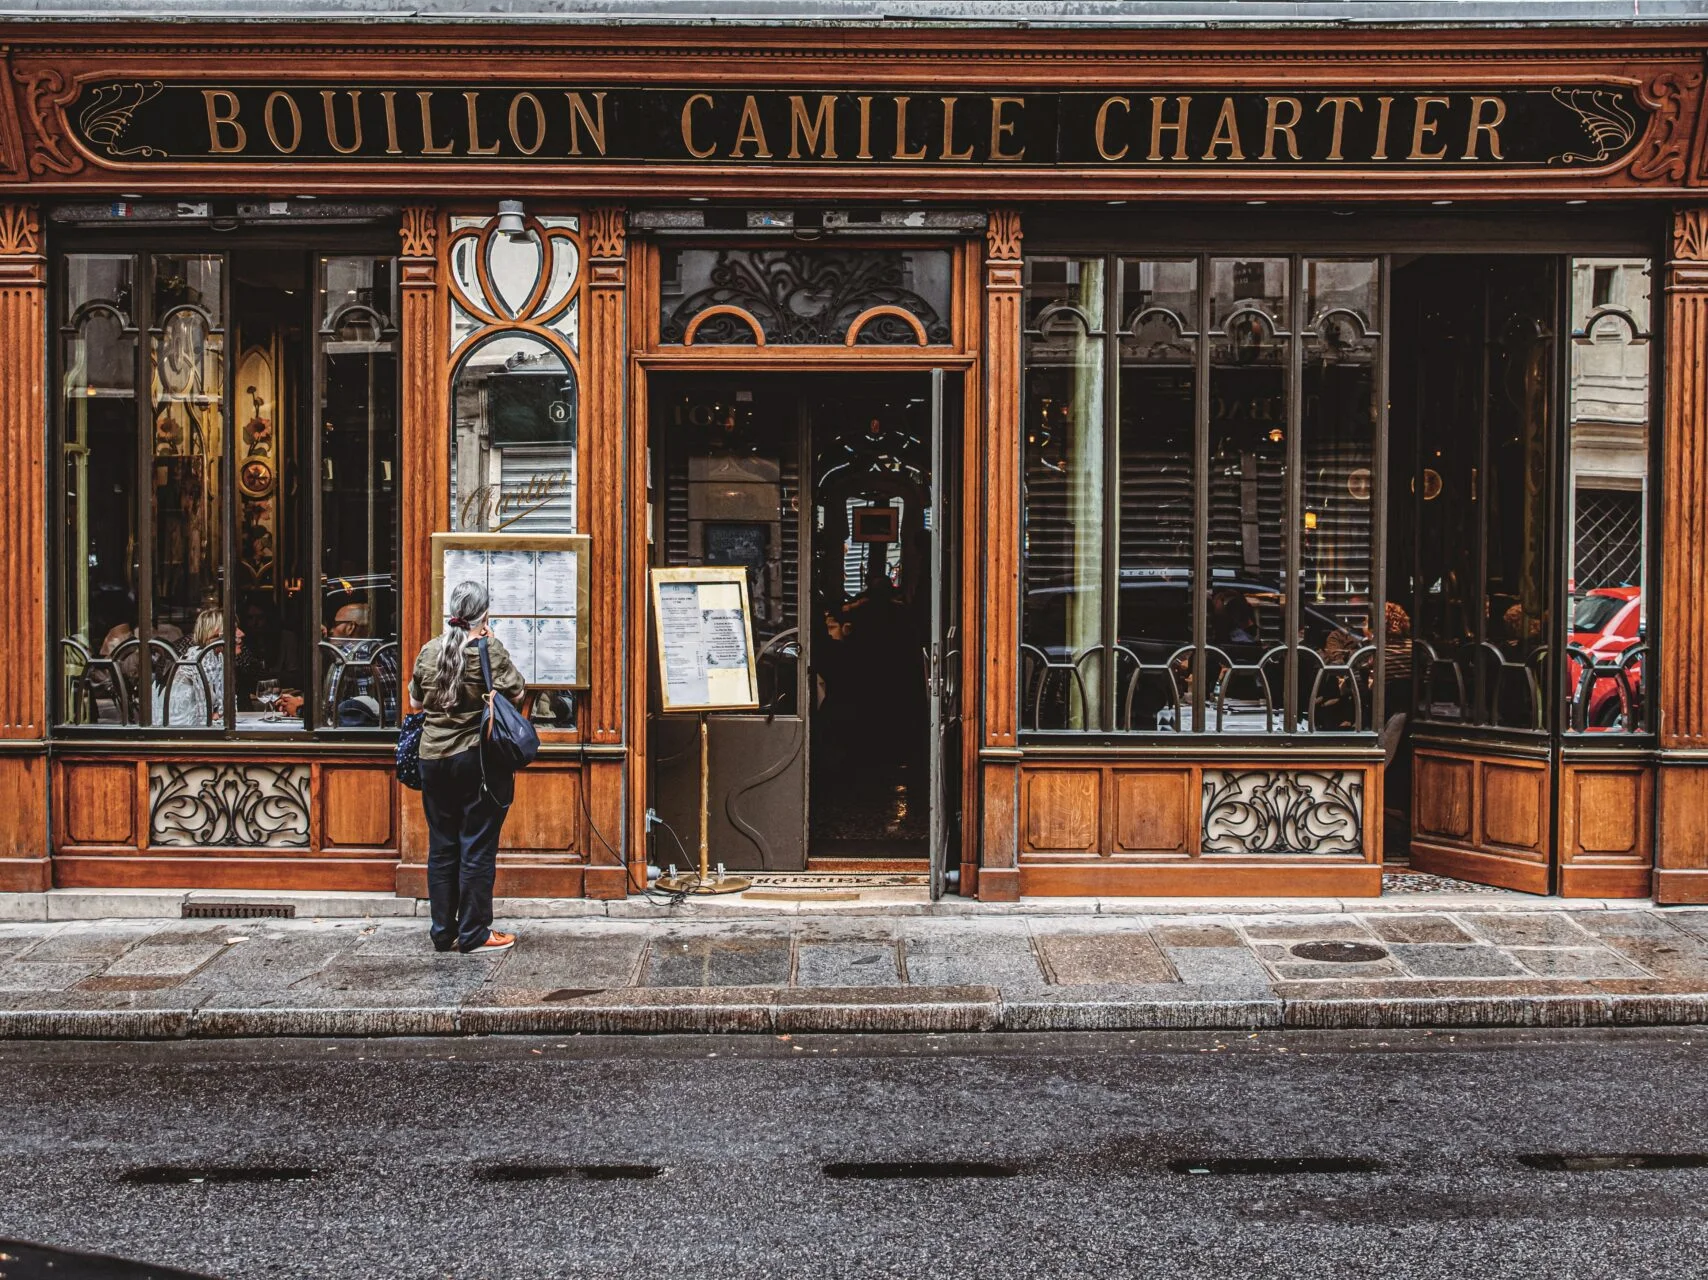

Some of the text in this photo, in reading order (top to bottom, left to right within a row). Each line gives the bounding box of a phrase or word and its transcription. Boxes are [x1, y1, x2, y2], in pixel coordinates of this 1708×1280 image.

[201, 89, 1507, 163] BOUILLON CAMILLE CHARTIER
